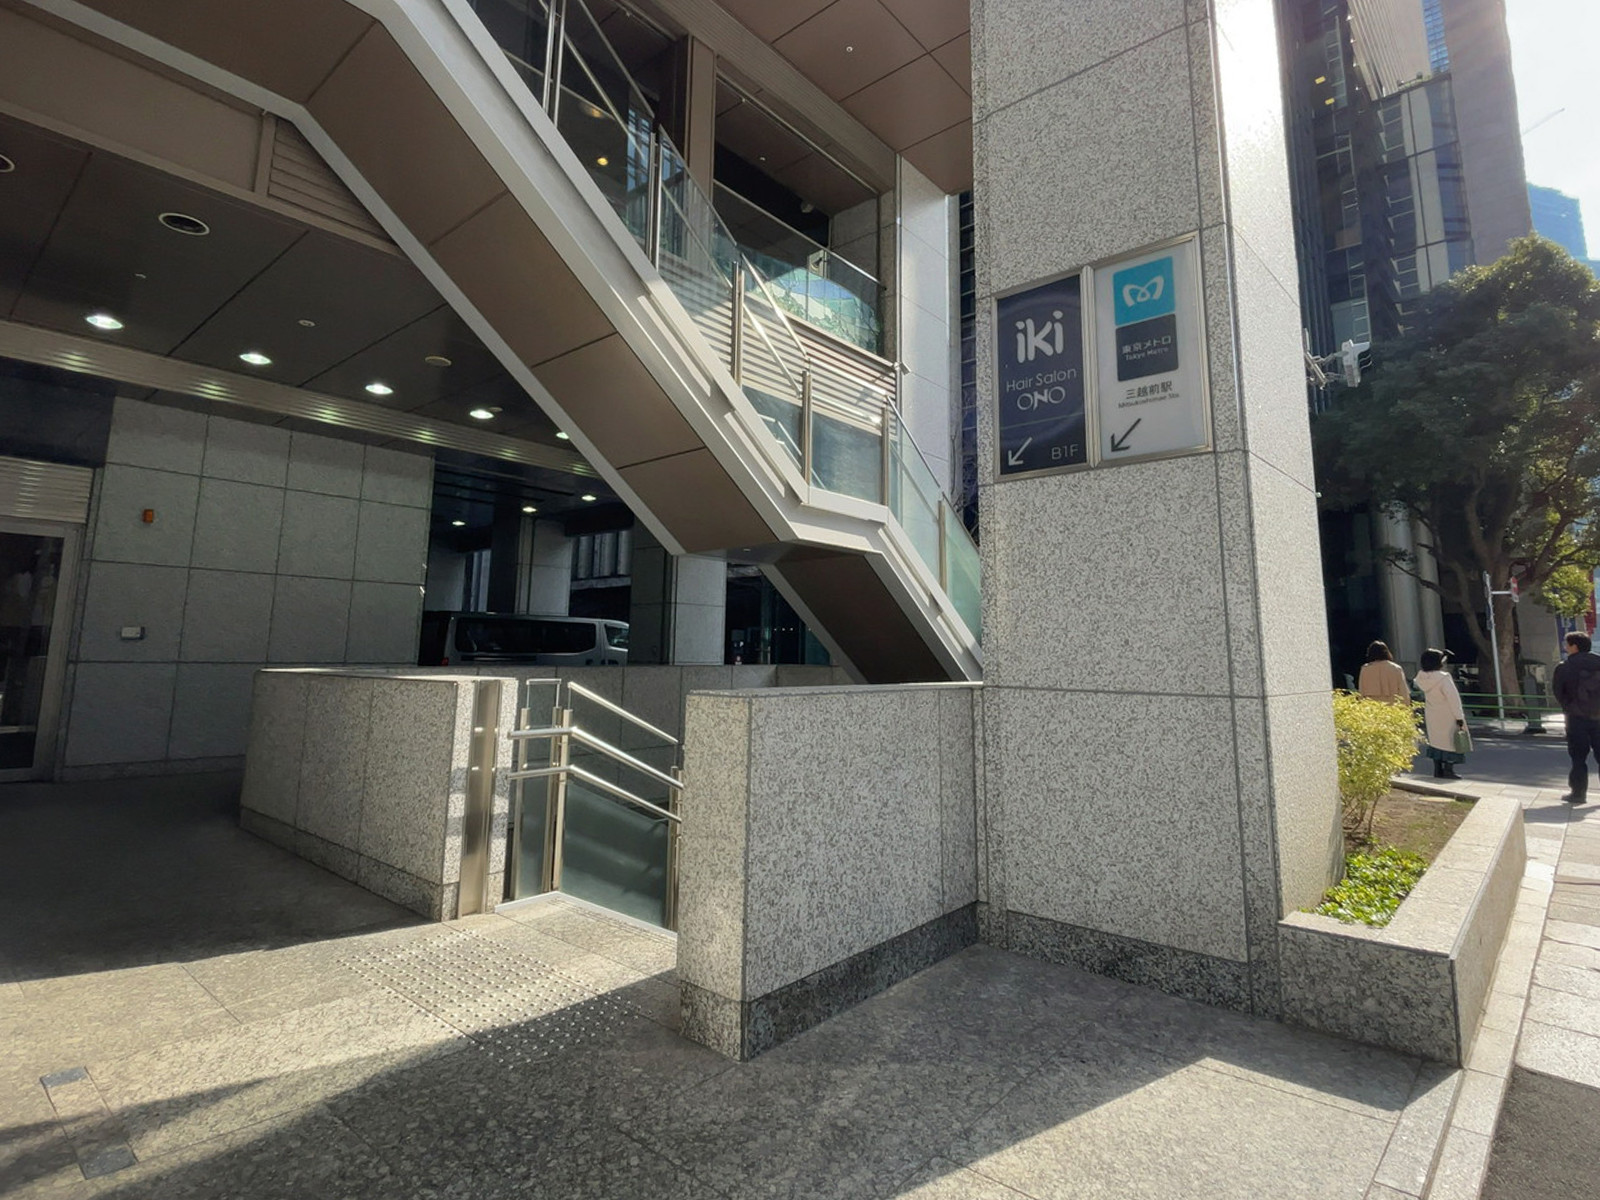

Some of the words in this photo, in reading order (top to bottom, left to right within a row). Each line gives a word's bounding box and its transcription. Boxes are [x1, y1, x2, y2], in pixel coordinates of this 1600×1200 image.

[1122, 335, 1171, 354] 東京メトロ
[1006, 376, 1033, 392] Hair
[1036, 368, 1077, 386] Salon
[1126, 380, 1173, 400] 三越前駅
[1017, 386, 1066, 410] ONO
[1051, 443, 1079, 460] B1F
